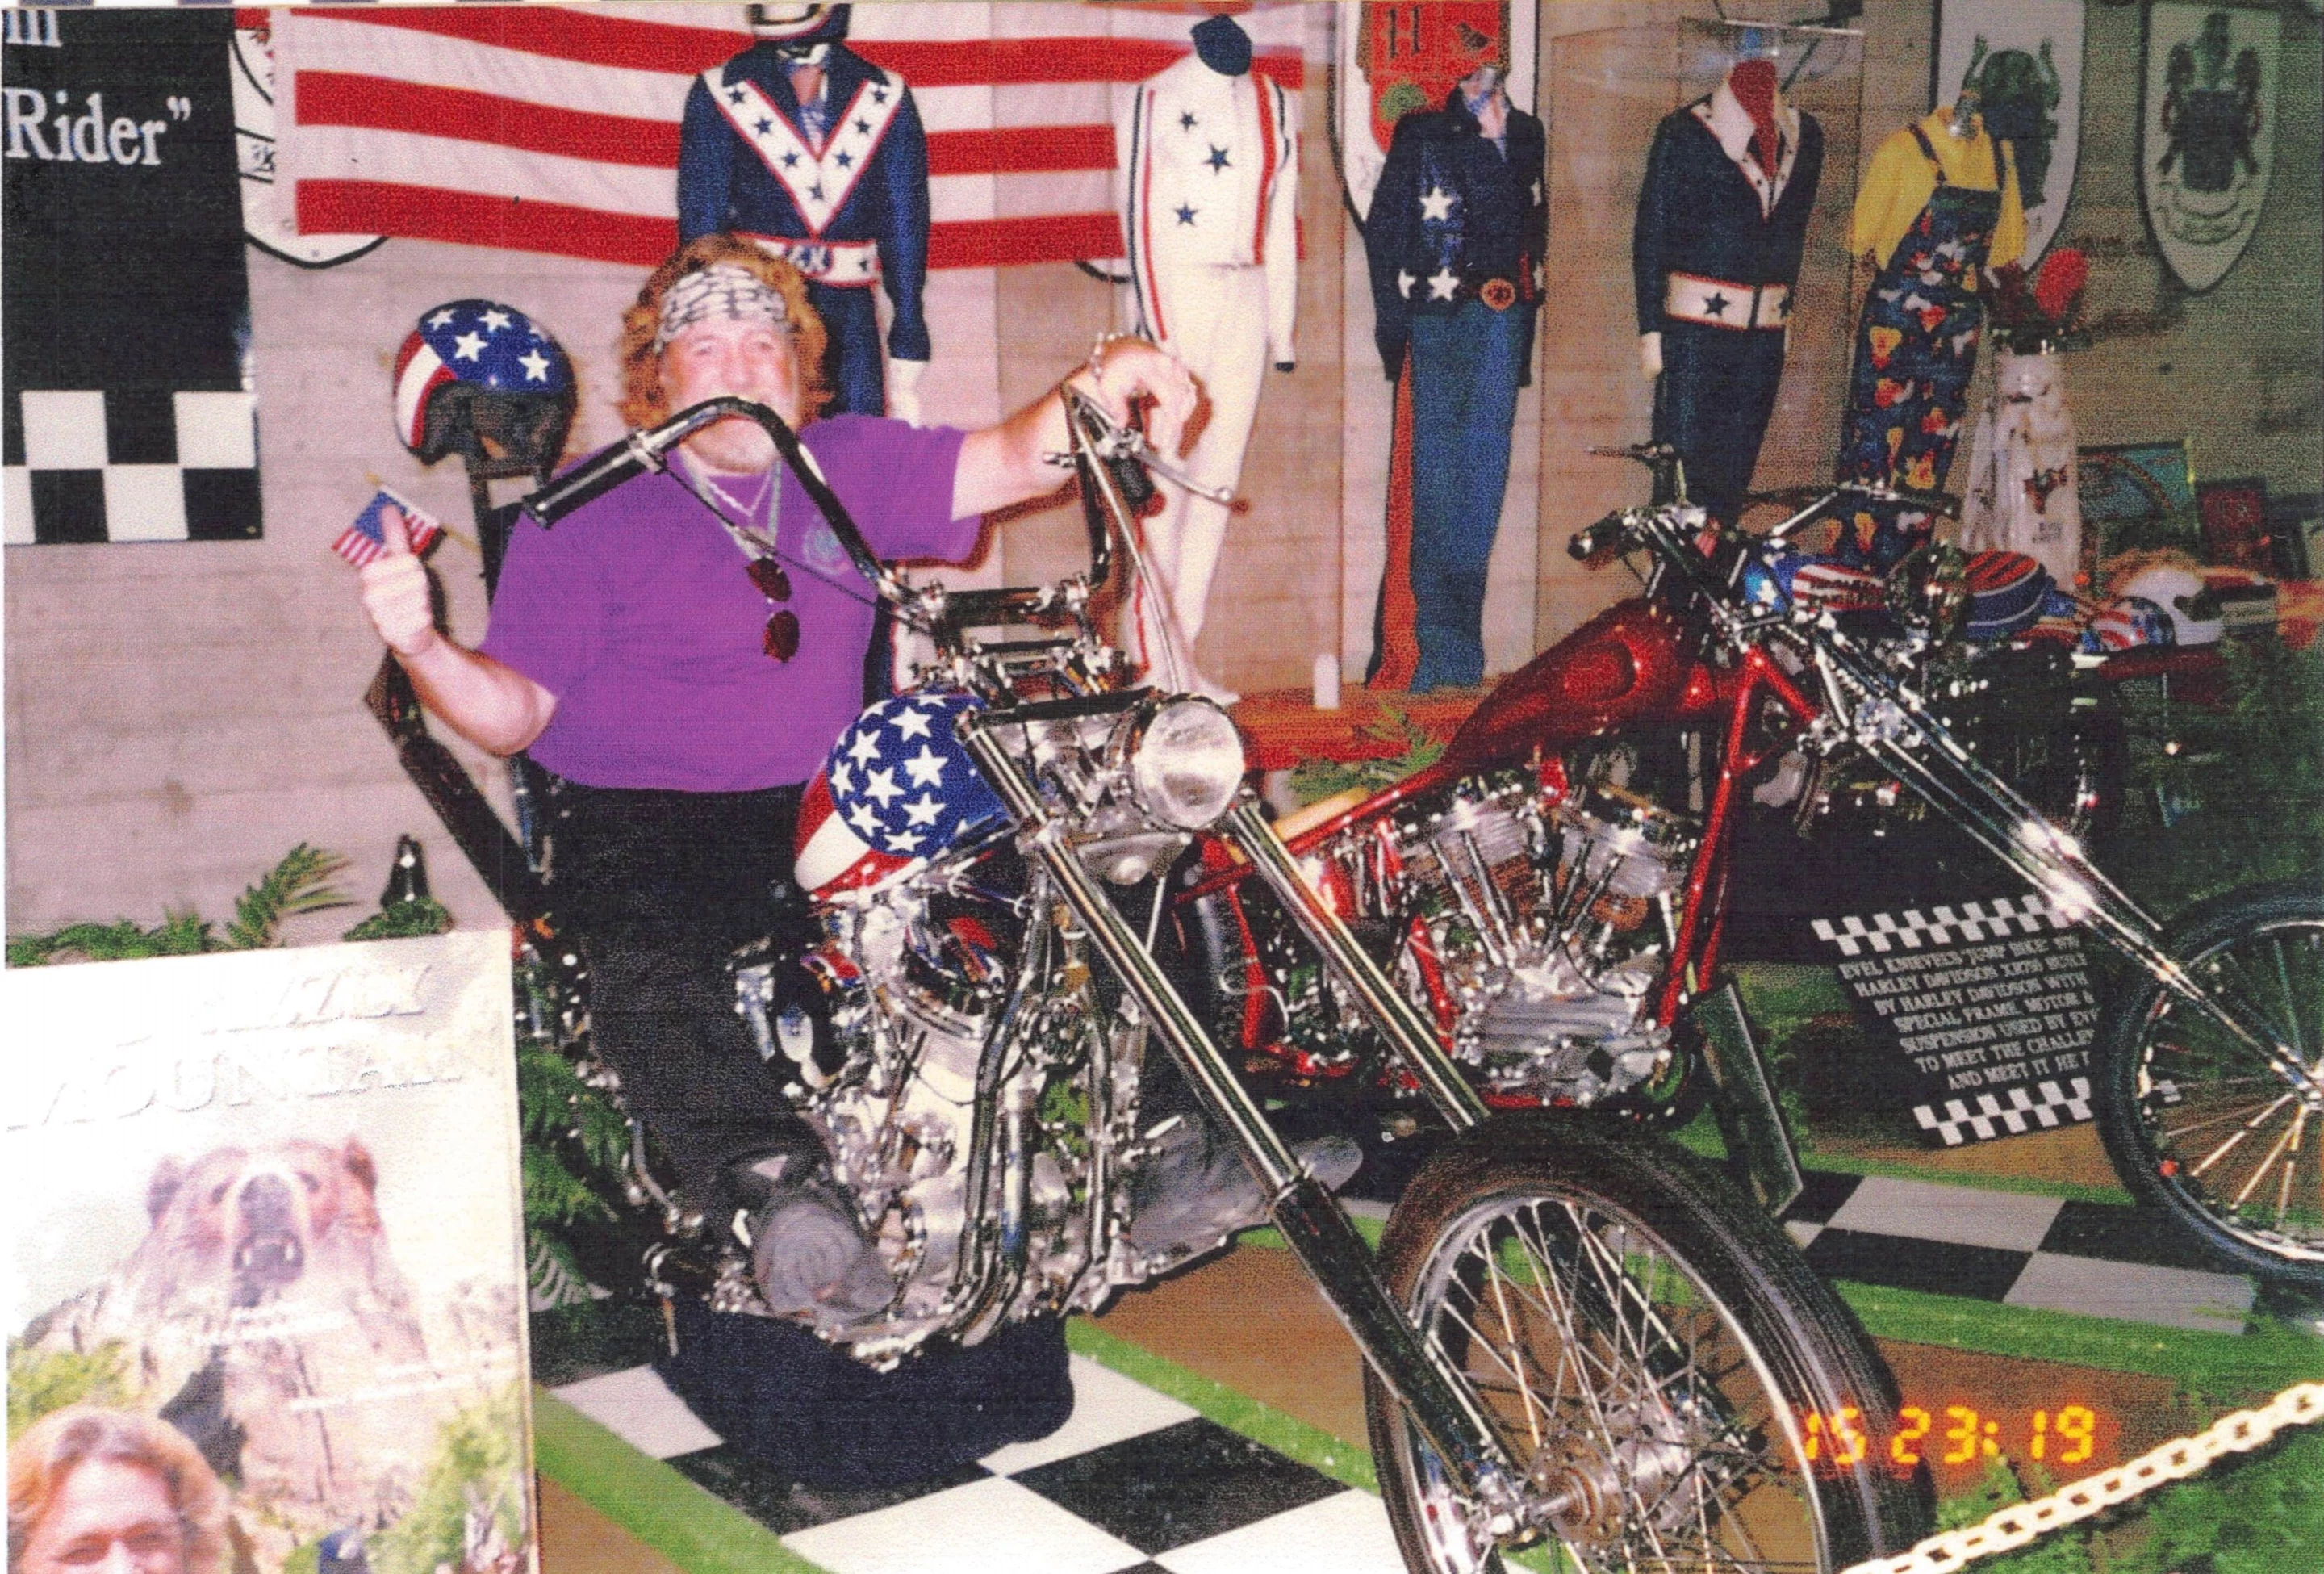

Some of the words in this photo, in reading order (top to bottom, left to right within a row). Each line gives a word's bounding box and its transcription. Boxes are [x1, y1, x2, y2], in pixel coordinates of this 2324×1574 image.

[1839, 963, 1883, 981] EVEL
[1854, 974, 1920, 998] HARLEY
[1922, 965, 1999, 989] DAVIDSON
[1873, 998, 1896, 1016] BY
[1900, 989, 1964, 1012] HARLEY
[1967, 977, 2043, 1002] DAVIDSON
[2043, 971, 2090, 989] WITH
[1893, 1011, 1962, 1033] SPECIAL
[2024, 991, 2082, 1012] MOTOR
[1899, 1025, 1997, 1054] SUSPENSION
[1996, 1018, 2043, 1038] USED
[2043, 1012, 2067, 1031] BY
[1913, 1056, 1940, 1074] TO
[1940, 1048, 1988, 1070] MEET
[1989, 1041, 2026, 1061] THE
[1947, 1070, 1983, 1090] AND
[1983, 1061, 2029, 1084] MEET
[2031, 1057, 2050, 1076] IT
[2054, 1053, 2080, 1072] HE
